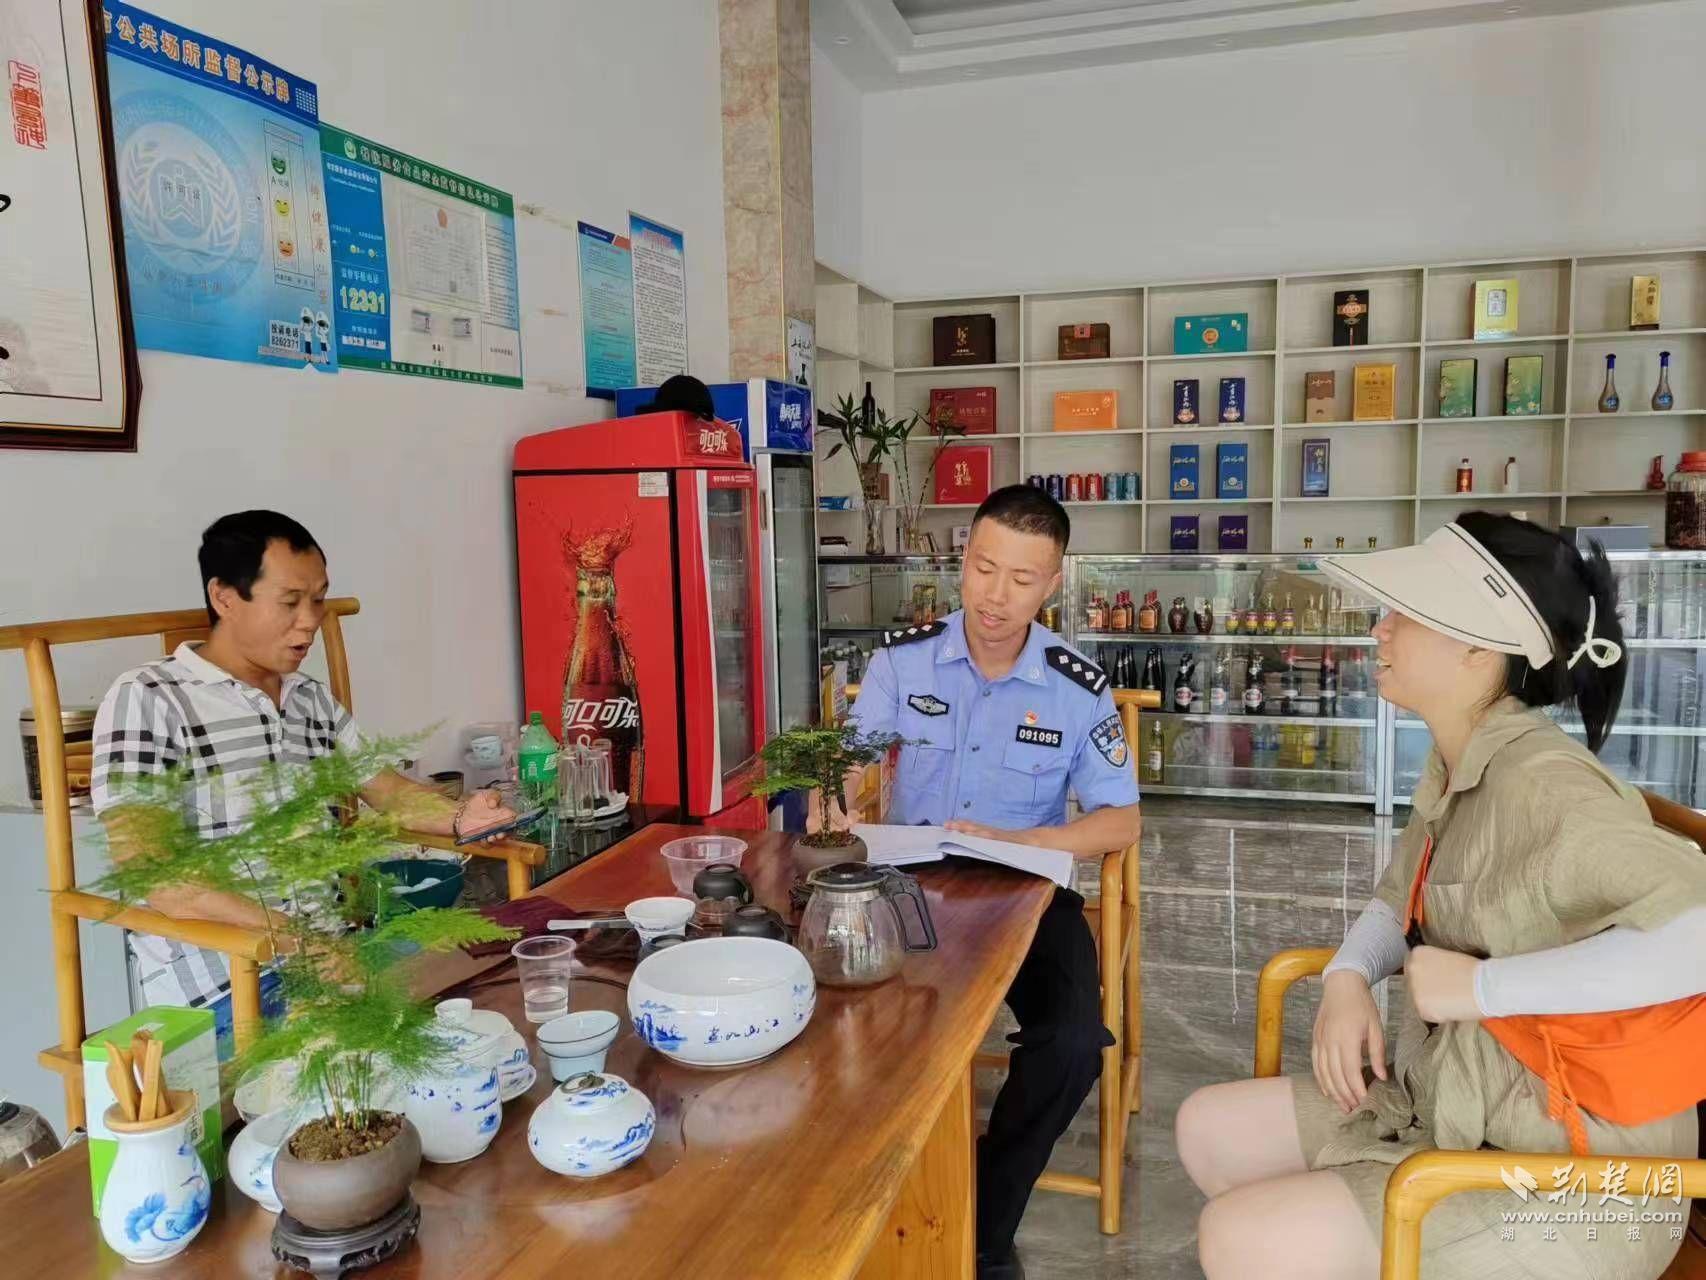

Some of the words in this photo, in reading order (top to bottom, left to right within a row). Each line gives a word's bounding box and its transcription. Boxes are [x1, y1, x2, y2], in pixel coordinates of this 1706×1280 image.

[699, 429, 729, 453] 可口可乐
[564, 696, 641, 729] 可口可乐
[1018, 729, 1060, 744] 091095
